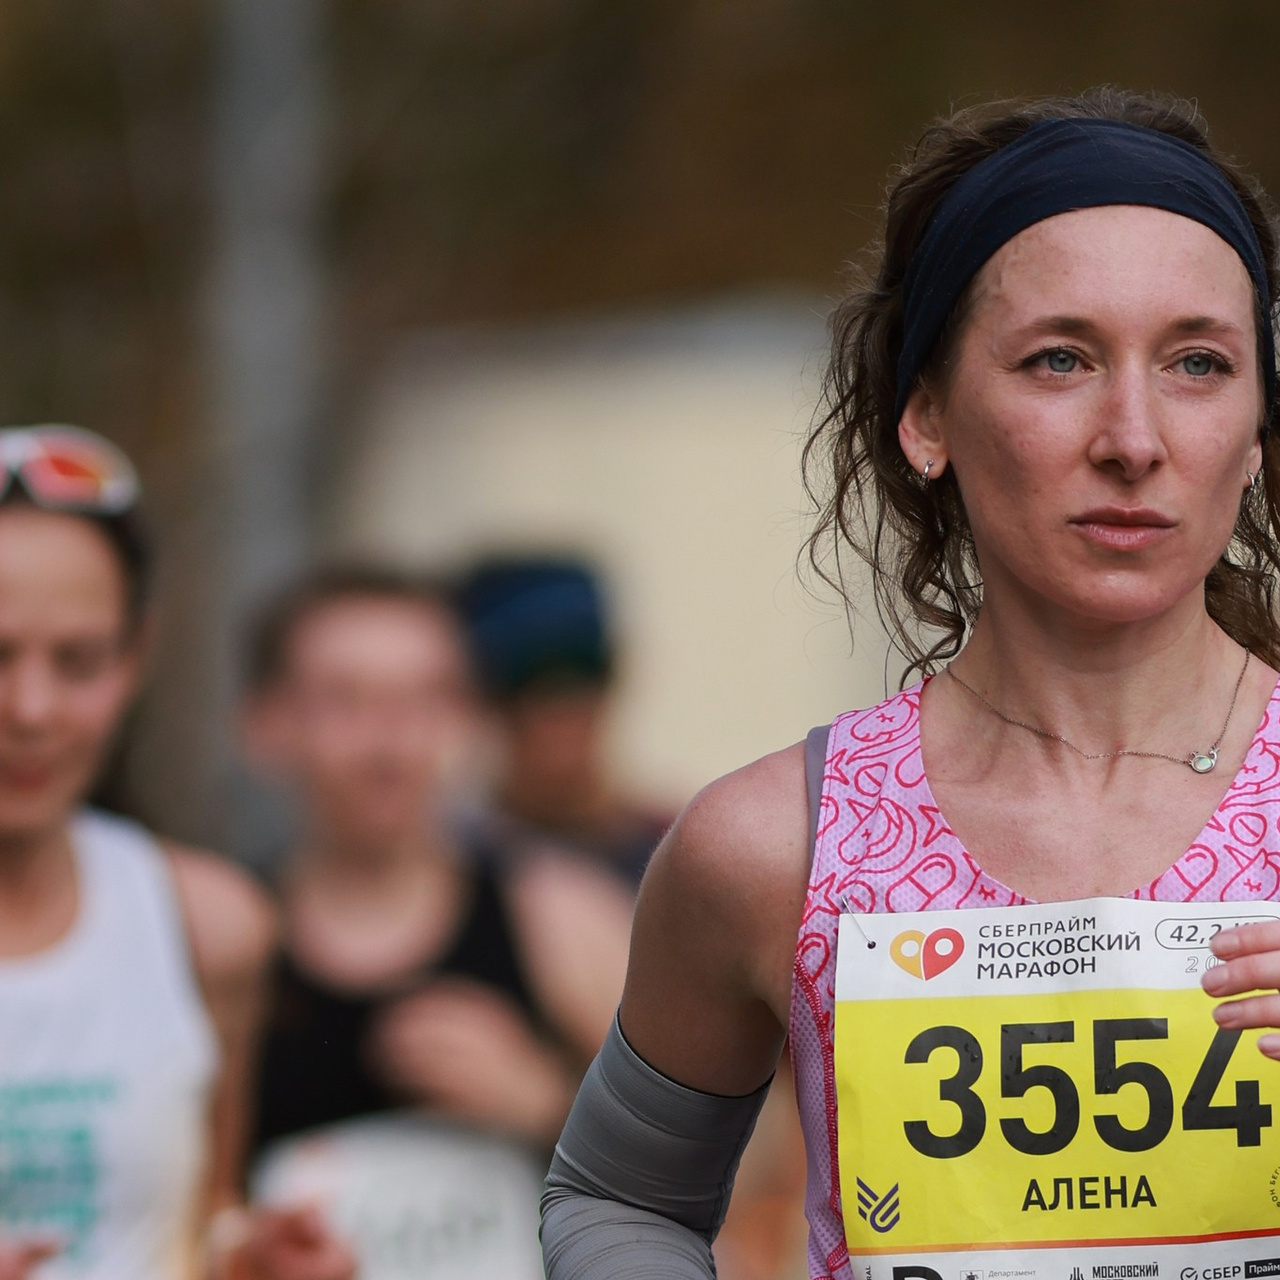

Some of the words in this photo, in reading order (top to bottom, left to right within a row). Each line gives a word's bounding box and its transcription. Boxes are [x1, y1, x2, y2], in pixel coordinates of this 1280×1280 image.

[979, 916, 1096, 938] СБЕРПРАЙМ
[977, 931, 1141, 959] МОСКОВСКИЙ
[976, 956, 1096, 980] МАРАФОН
[903, 1017, 1273, 1159] 3554
[1021, 1175, 1157, 1212] АЛЕНА
[988, 1270, 1036, 1279] Департамент
[1092, 1261, 1159, 1279] МОСКОВСКИЙ
[1202, 1265, 1241, 1280] СБЕР
[1248, 1262, 1280, 1275] Прайм
